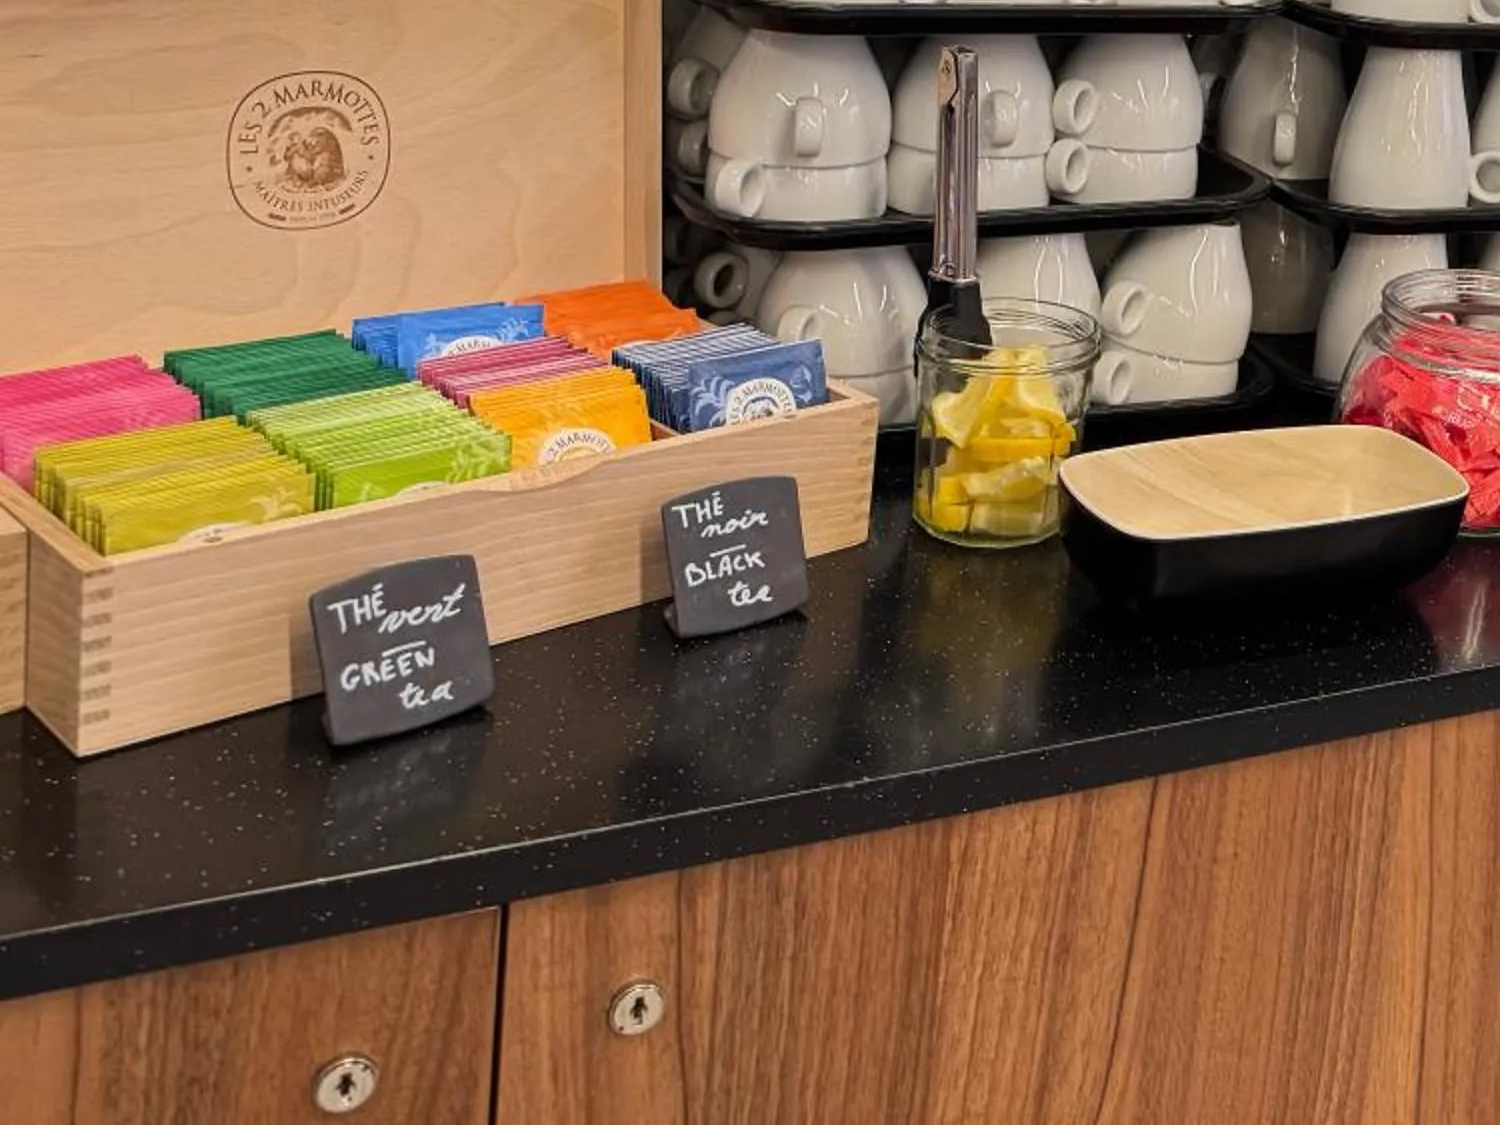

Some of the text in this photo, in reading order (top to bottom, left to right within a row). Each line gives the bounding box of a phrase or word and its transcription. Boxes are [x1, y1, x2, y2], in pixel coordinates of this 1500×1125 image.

[238, 79, 380, 154] LES 2 MARMOTTES
[700, 509, 769, 538] noir
[684, 551, 766, 587] BLACK
[377, 582, 466, 633] vert
[339, 646, 436, 692] GREEN
[398, 680, 455, 710] tea
